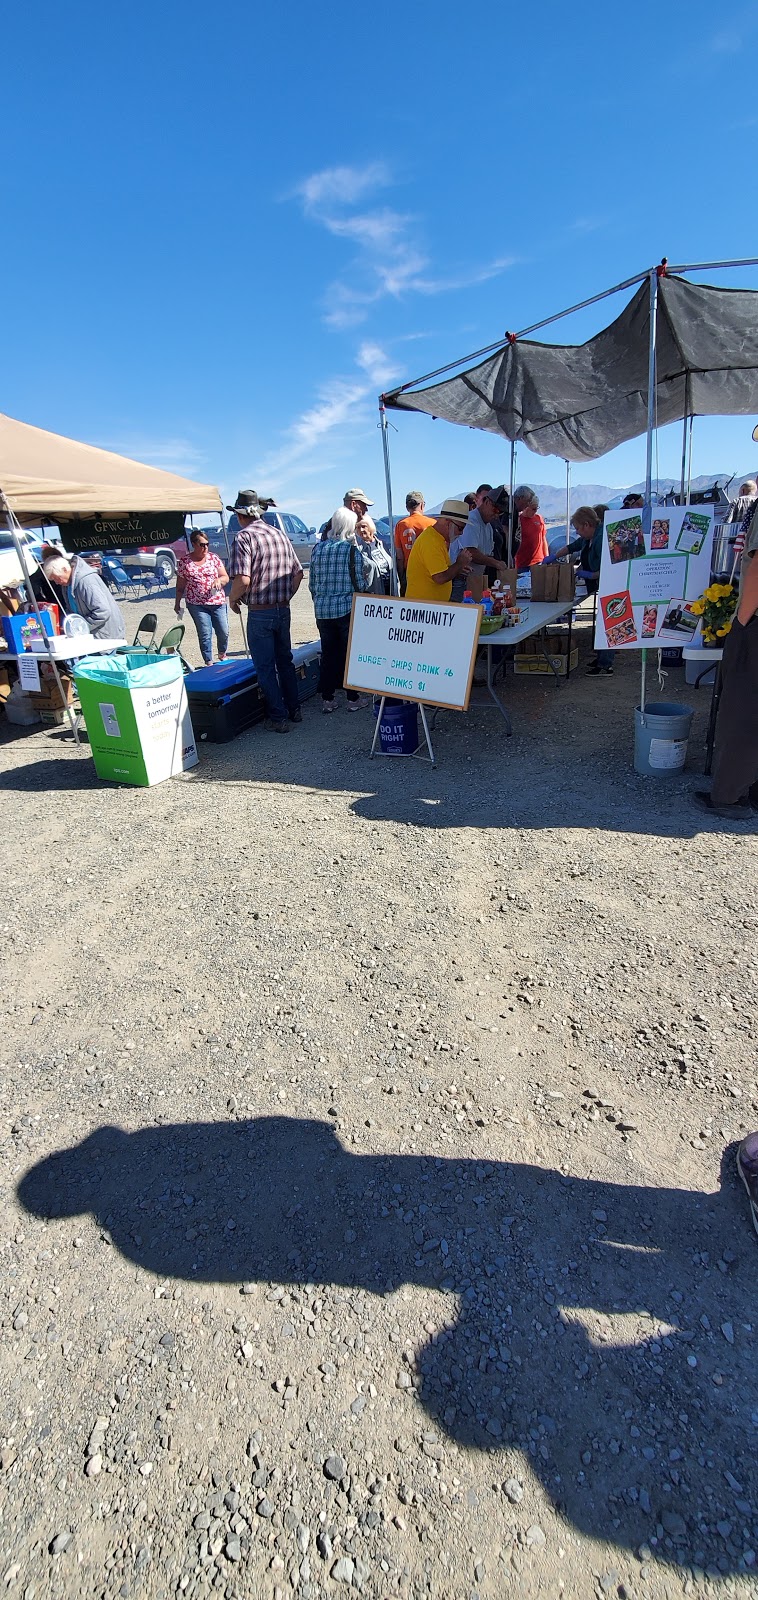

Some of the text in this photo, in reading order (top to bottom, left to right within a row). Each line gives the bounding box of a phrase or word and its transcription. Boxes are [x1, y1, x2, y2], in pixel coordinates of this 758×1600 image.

[94, 520, 142, 532] GFWC-AZ
[109, 533, 147, 545] Women's
[150, 529, 170, 541] Club
[363, 604, 456, 627] GRACE COMMUNITY
[388, 627, 424, 645] CHURCH
[357, 654, 387, 666] BURGE
[391, 659, 412, 672] CHIPS
[416, 665, 440, 676] DRINK
[384, 676, 426, 692] DRINKS $1
[152, 693, 172, 705] better
[148, 703, 179, 719] tomorrow
[380, 725, 404, 734] DO IT
[381, 733, 405, 742] RIGHT
